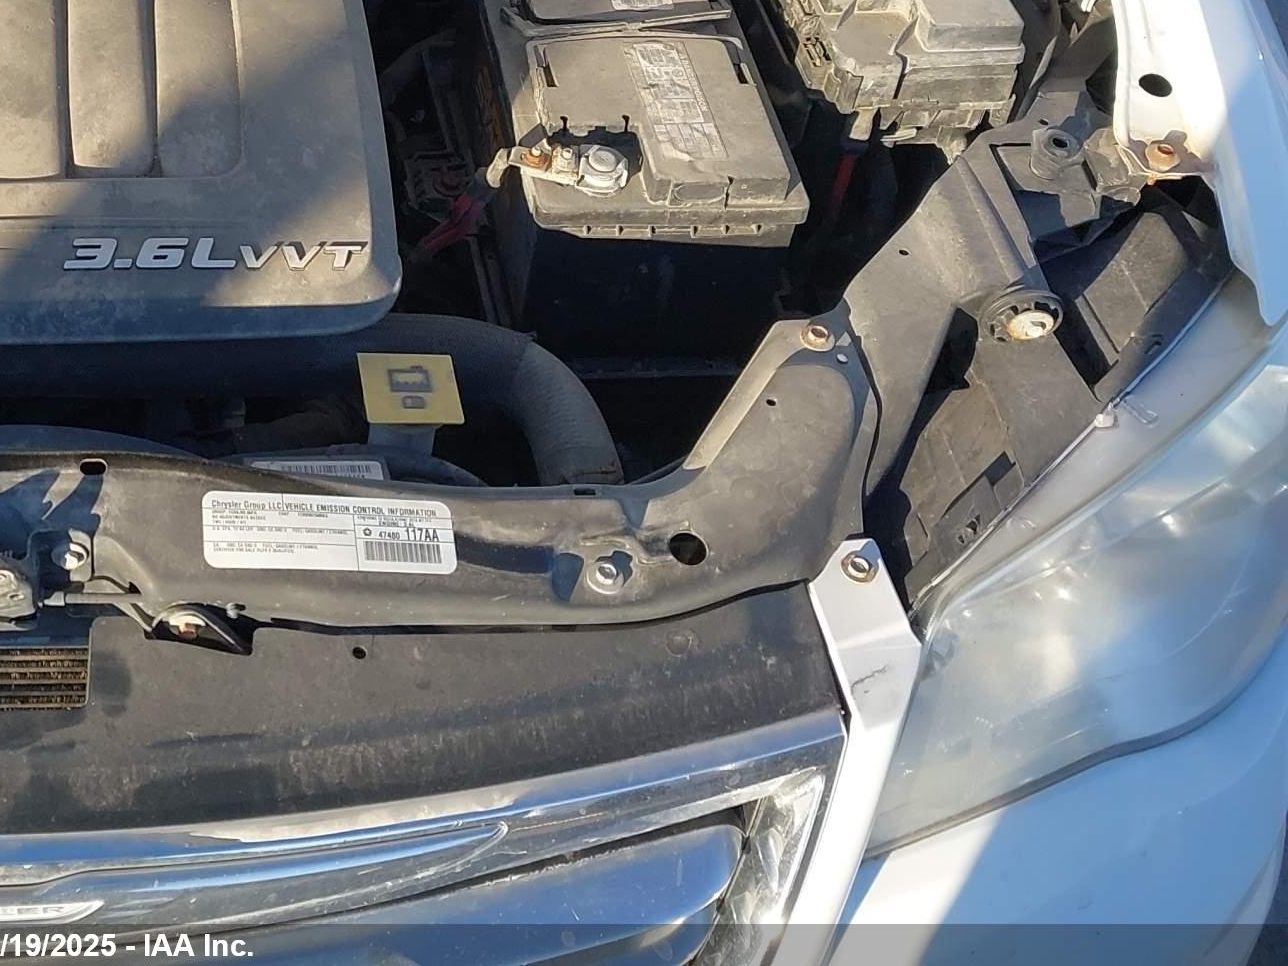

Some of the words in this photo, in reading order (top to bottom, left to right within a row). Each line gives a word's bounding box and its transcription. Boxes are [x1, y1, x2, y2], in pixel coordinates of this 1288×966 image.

[212, 500, 242, 510] Chrysler
[244, 500, 266, 510] Group
[268, 501, 282, 510] LLC
[284, 502, 314, 512] VEHICLE
[316, 504, 350, 513] EMISSION
[352, 506, 385, 515] CONTROL
[387, 507, 436, 517] INFORMATION
[405, 528, 440, 542] 117AA
